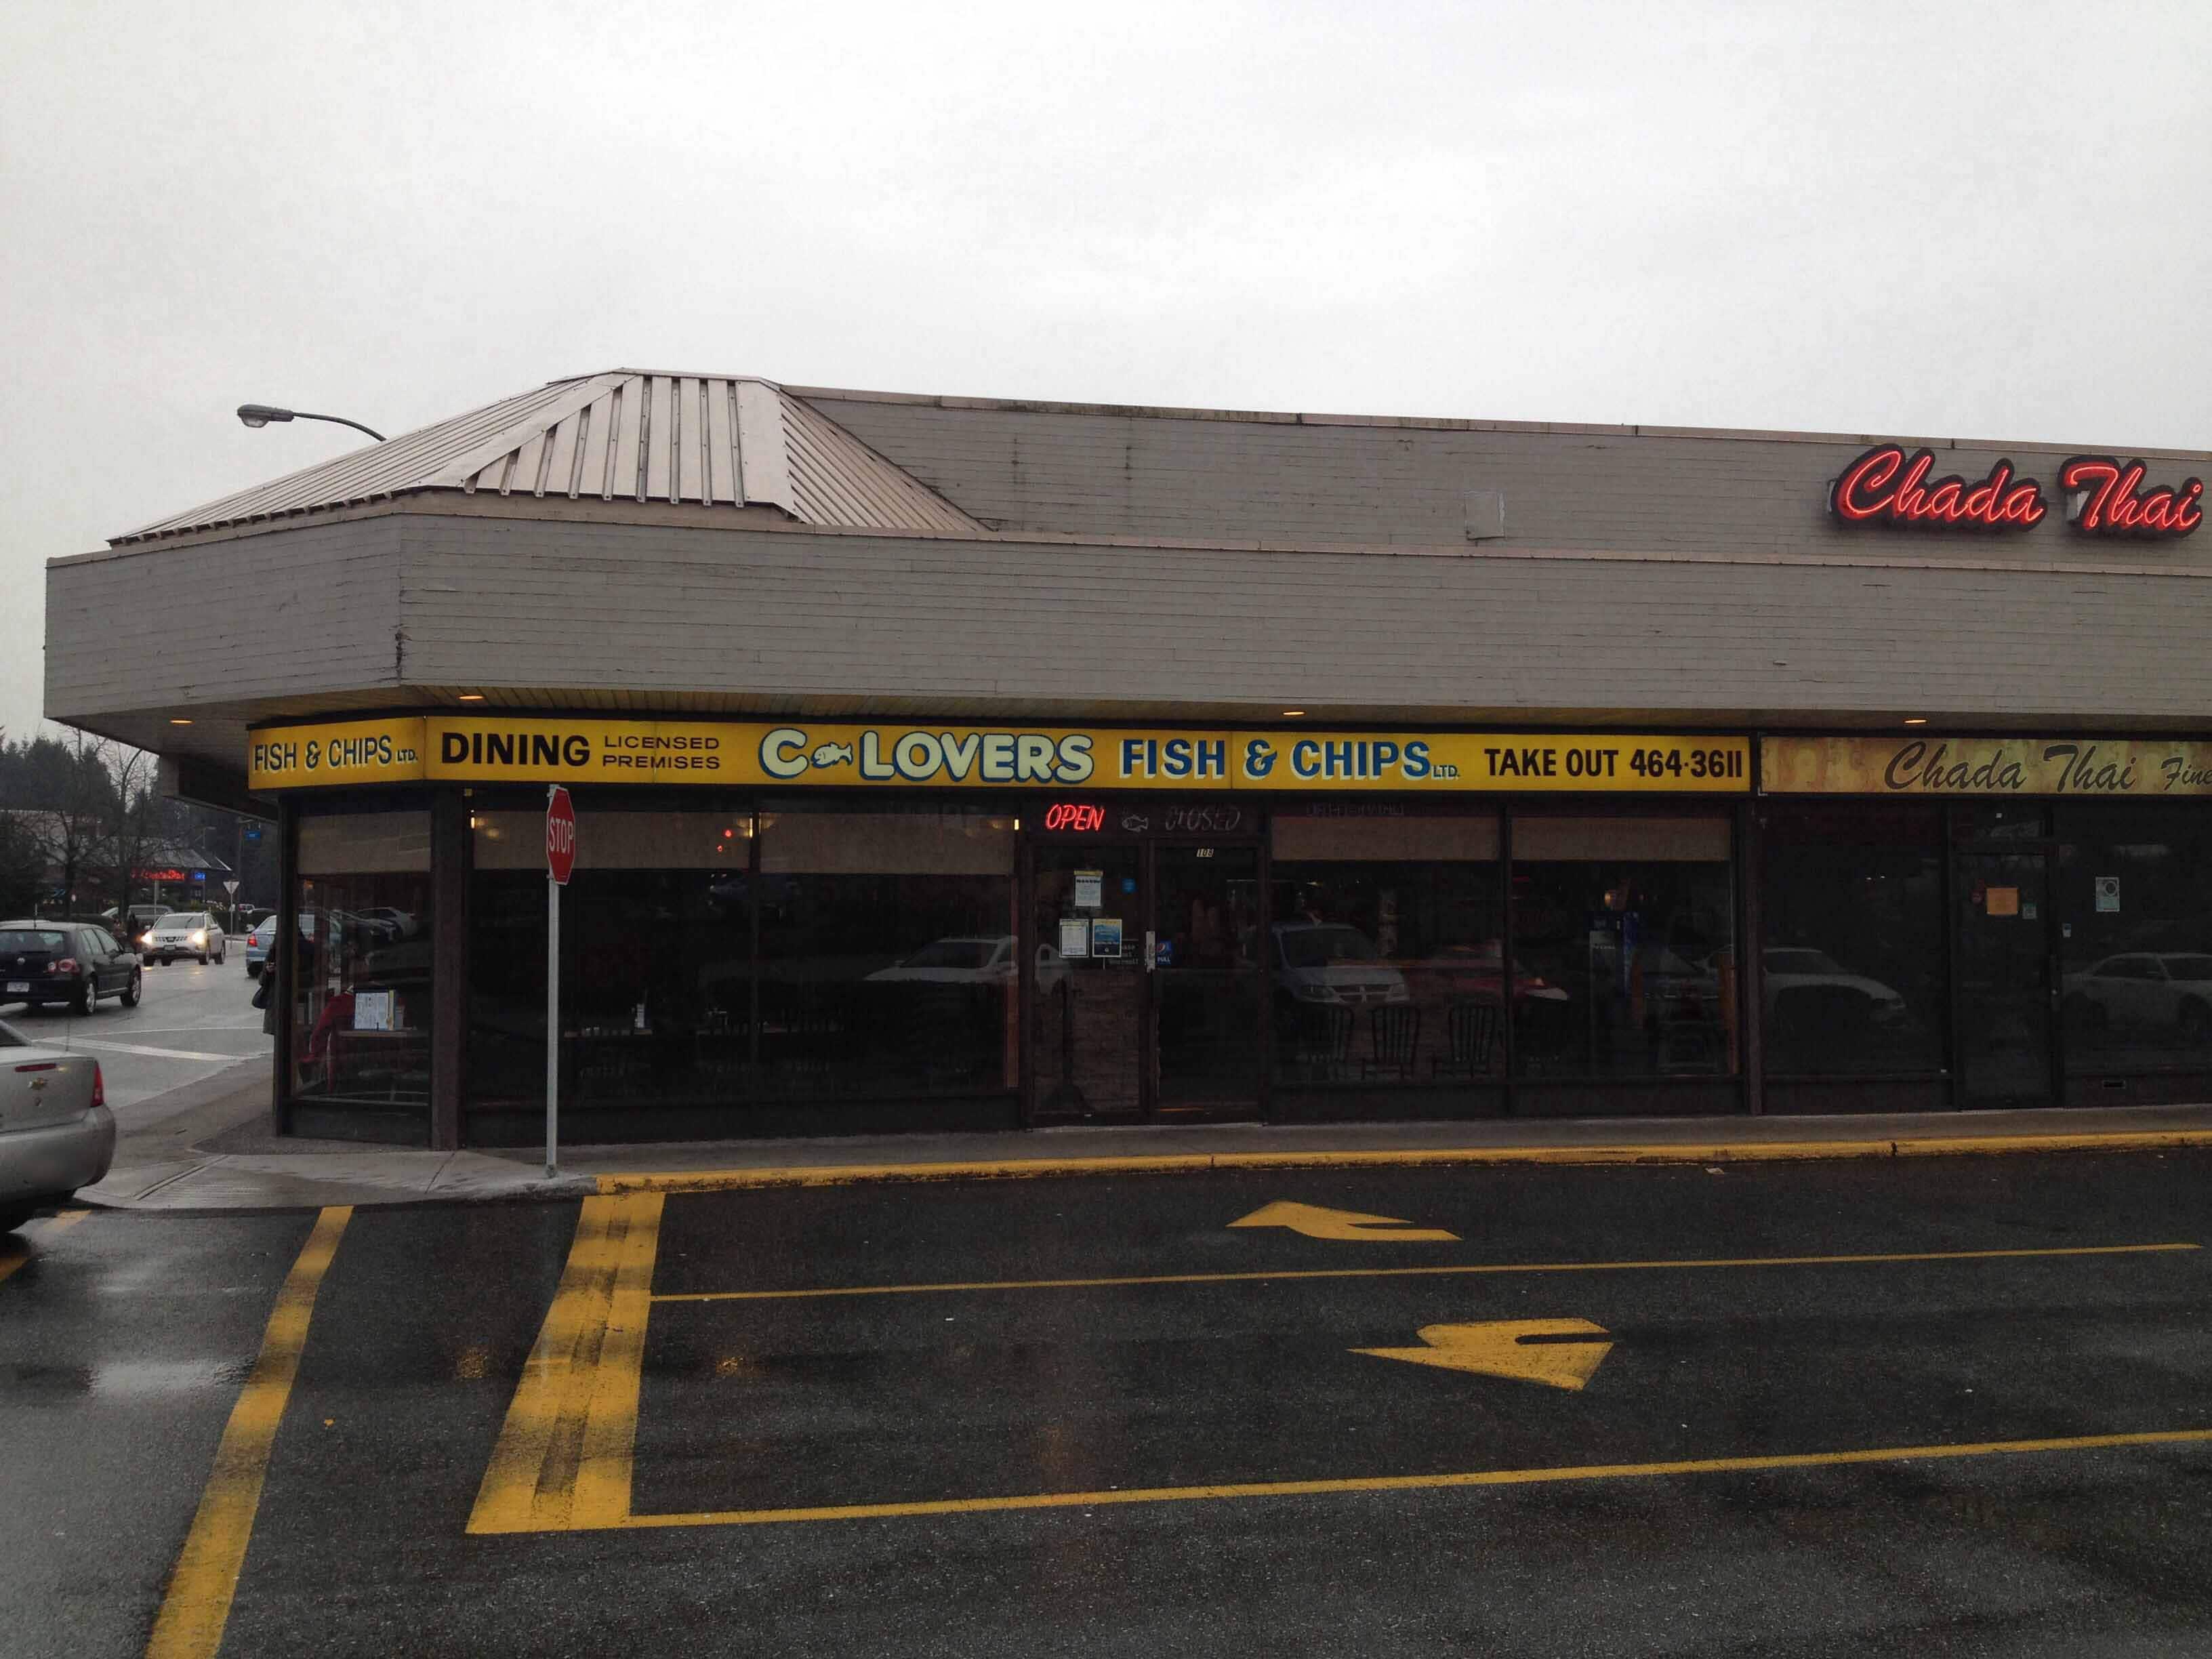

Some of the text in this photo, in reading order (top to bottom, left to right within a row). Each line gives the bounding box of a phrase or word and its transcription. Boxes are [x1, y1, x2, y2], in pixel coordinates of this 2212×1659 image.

[1837, 445, 2204, 531] Chada Thai
[253, 735, 418, 772] FISH & CHIPS LTD.
[441, 732, 591, 766] DINING
[605, 735, 720, 750] LICENSED
[758, 727, 1460, 784] C LOVERS FISH & CHIPS LTD.
[602, 754, 720, 770] PREMISES
[1485, 747, 1557, 778] TAKE
[1566, 749, 1620, 778] OUT
[1884, 741, 2027, 791] Chada
[2043, 745, 2137, 793] Thai
[1045, 803, 1105, 831] OPEN
[549, 817, 574, 855] STOP
